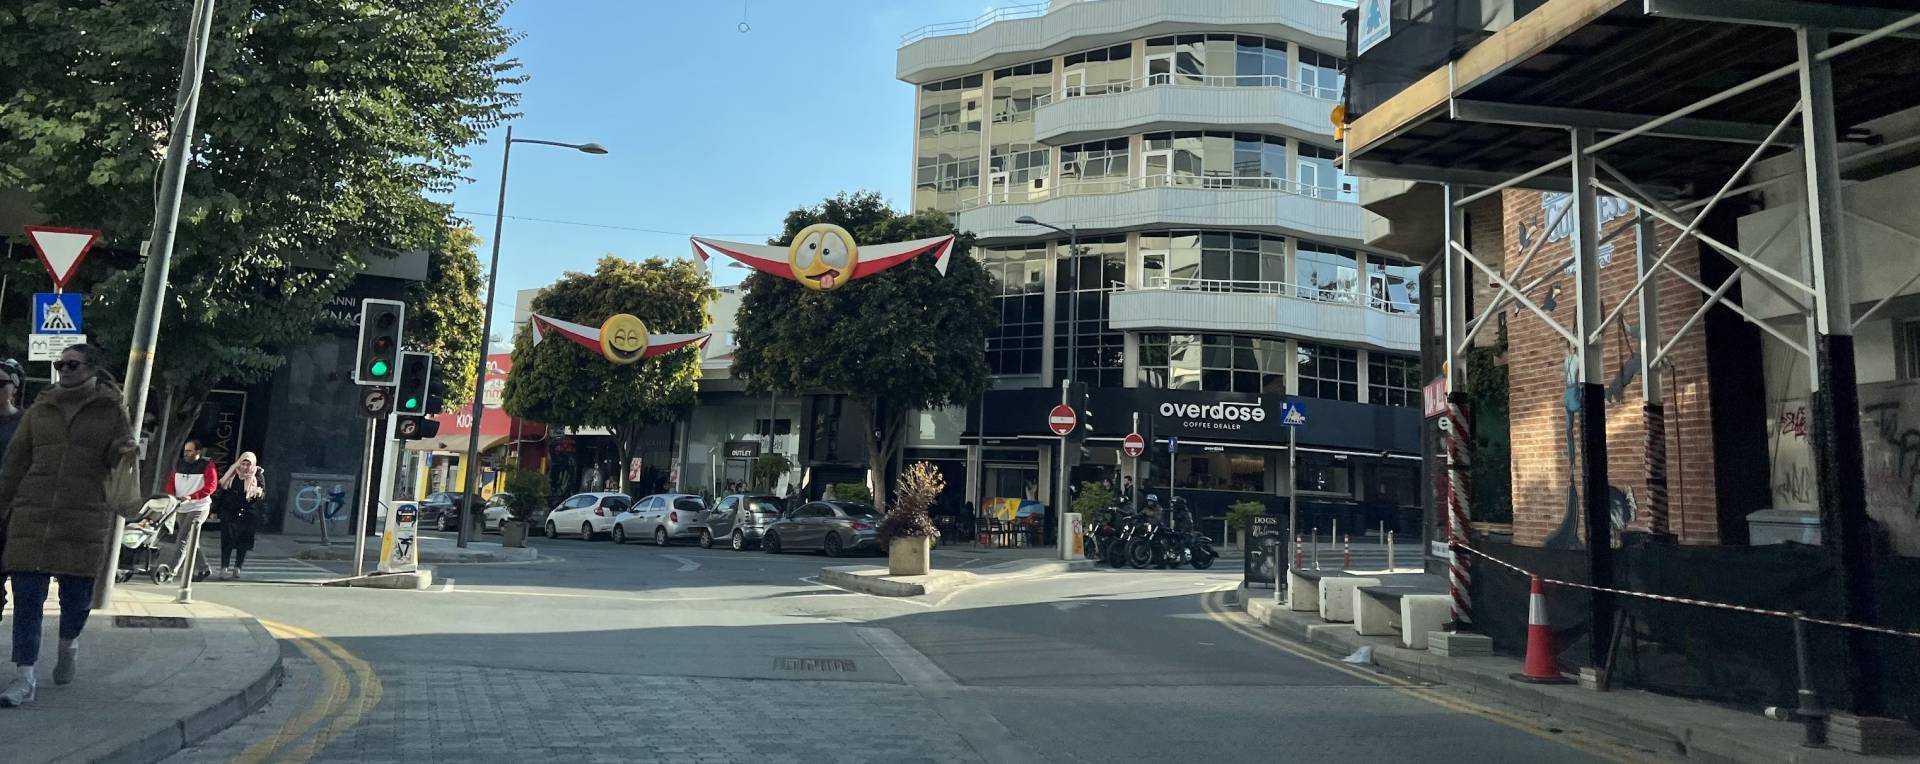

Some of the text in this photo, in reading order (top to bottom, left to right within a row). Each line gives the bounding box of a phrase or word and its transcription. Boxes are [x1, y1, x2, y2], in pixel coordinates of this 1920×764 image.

[1160, 397, 1265, 421] overdose
[1183, 421, 1211, 429] COFFEE
[731, 449, 752, 457] OUTLET
